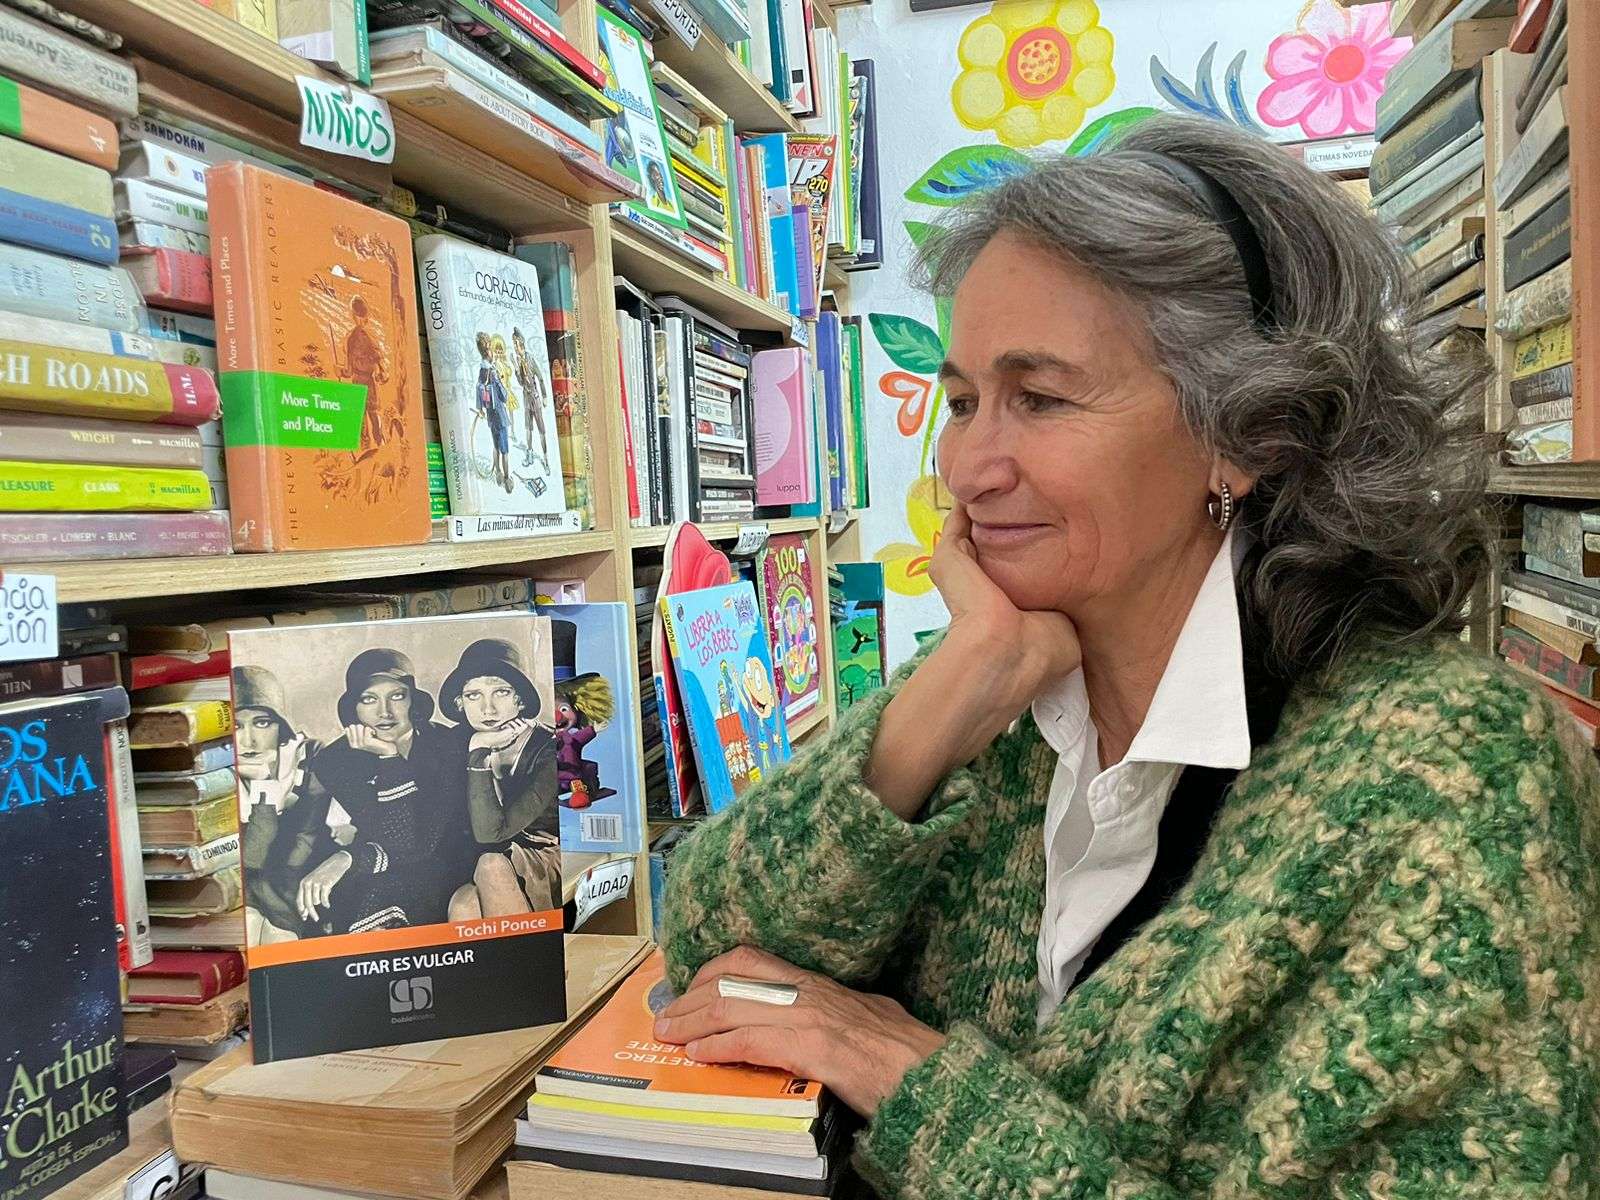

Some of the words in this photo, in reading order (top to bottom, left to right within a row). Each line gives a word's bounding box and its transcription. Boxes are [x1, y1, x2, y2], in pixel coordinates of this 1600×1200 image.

[660, 0, 700, 40] EPORTES
[303, 86, 391, 156] NIÑOS
[808, 177, 829, 193] 270
[263, 182, 281, 285] READERS
[219, 236, 230, 271] Places
[223, 275, 233, 296] and
[425, 260, 444, 330] CORAZON
[475, 271, 533, 305] CORAZON
[225, 299, 236, 335] Times
[273, 300, 287, 366] BASIC
[228, 338, 238, 369] More
[46, 356, 150, 397] ROADS
[281, 391, 309, 408] More
[311, 393, 341, 412] Times
[69, 430, 116, 445] WRIGHT
[282, 417, 301, 431] and
[304, 417, 334, 434] Places
[0, 480, 55, 493] LEASURE
[284, 452, 297, 494] NEW
[776, 483, 801, 494] luppa
[289, 506, 299, 544] THE
[477, 517, 491, 533] Las
[492, 517, 514, 532] minas
[514, 516, 524, 530] del
[524, 518, 535, 531] rey
[4, 679, 32, 695] NEIL
[202, 840, 238, 860] EDMUNDO
[455, 923, 498, 939] Tochi
[500, 916, 547, 933] Ponce
[345, 957, 391, 978] CITAR
[392, 956, 411, 973] ES
[412, 949, 475, 970] VULGAR
[3, 1034, 118, 1117] Arthur
[6, 1079, 119, 1159] Clarke
